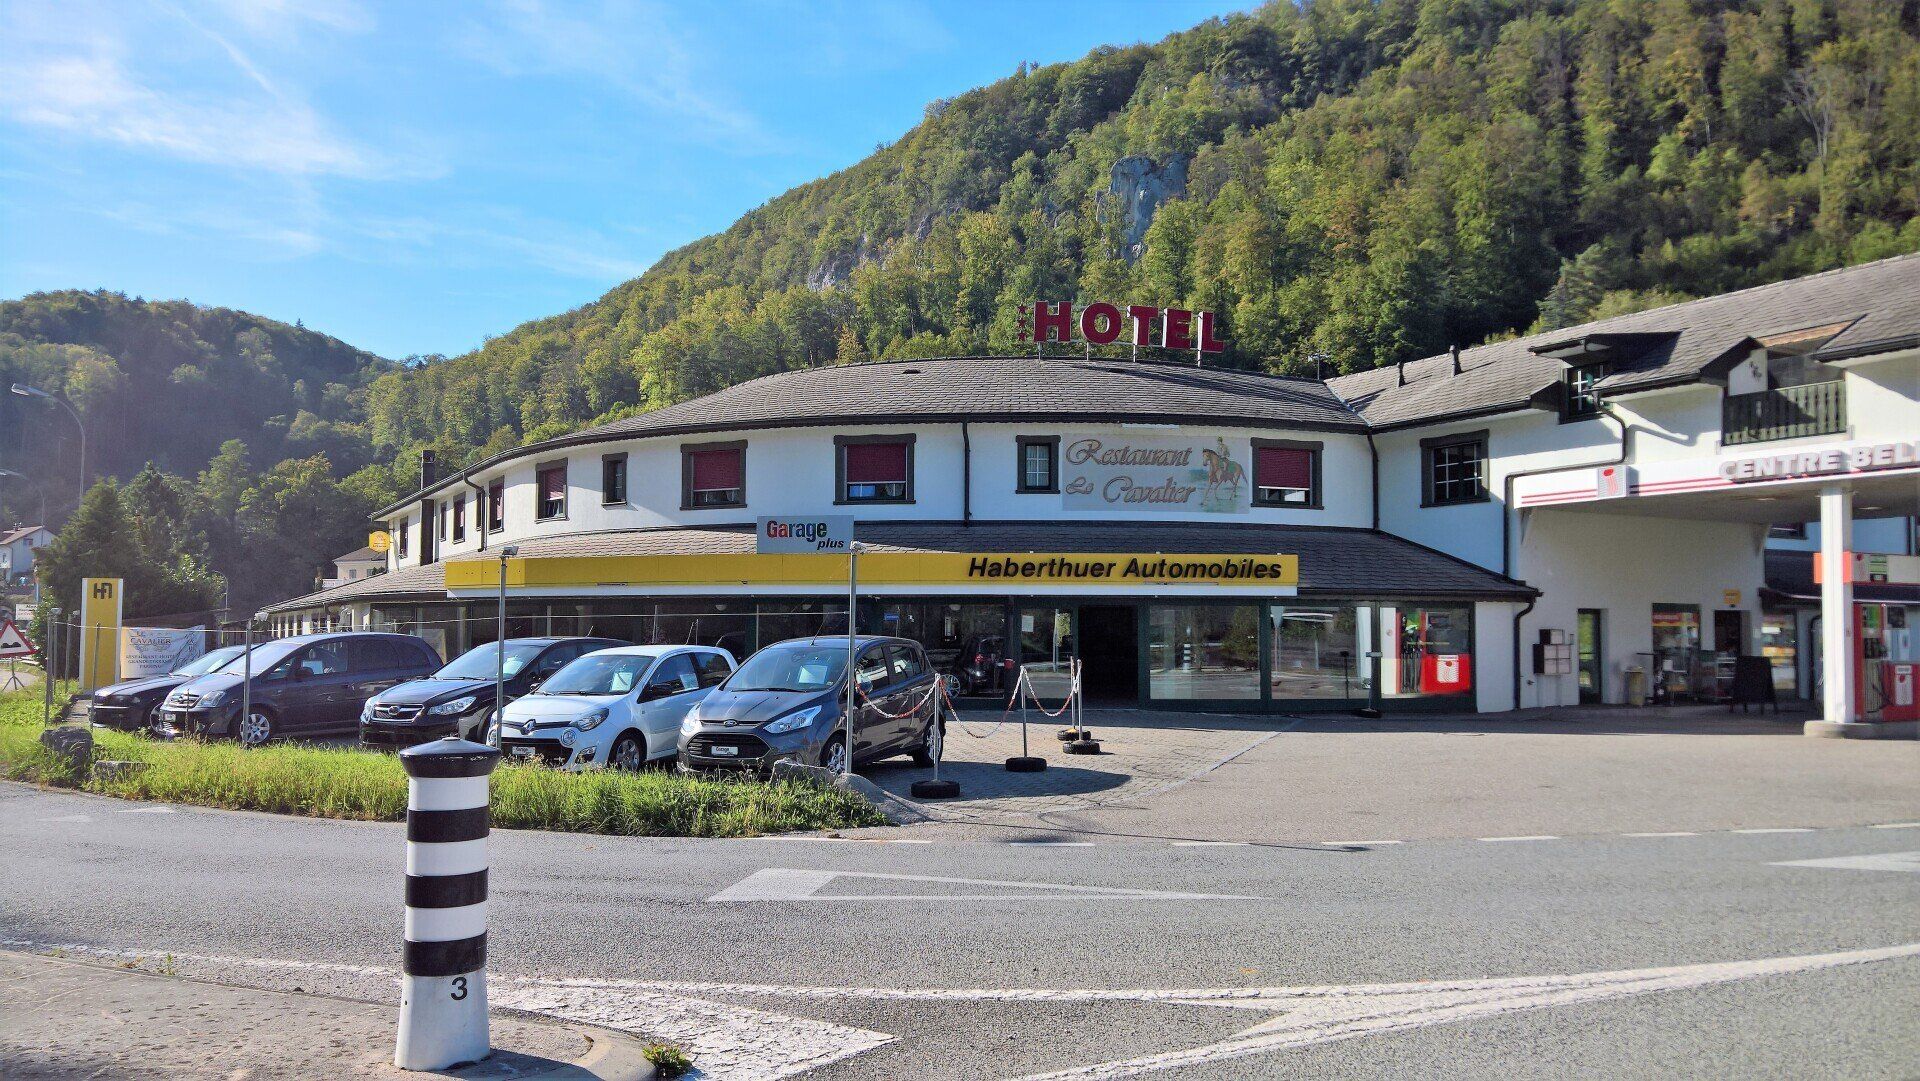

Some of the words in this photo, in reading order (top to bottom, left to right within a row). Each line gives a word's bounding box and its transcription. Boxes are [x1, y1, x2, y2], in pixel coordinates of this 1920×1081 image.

[1033, 301, 1225, 353] HOTEL
[1066, 439, 1193, 467] Restaurant
[1719, 450, 1843, 479] CENTRE
[1066, 476, 1094, 495] Le
[1103, 475, 1197, 503] Cavalier
[766, 520, 827, 542] Garage
[817, 538, 845, 550] plus
[968, 557, 1117, 578] Haberthuer
[1122, 558, 1283, 579] Automobiles
[130, 637, 172, 645] CAVALIER
[450, 976, 468, 1001] 3
